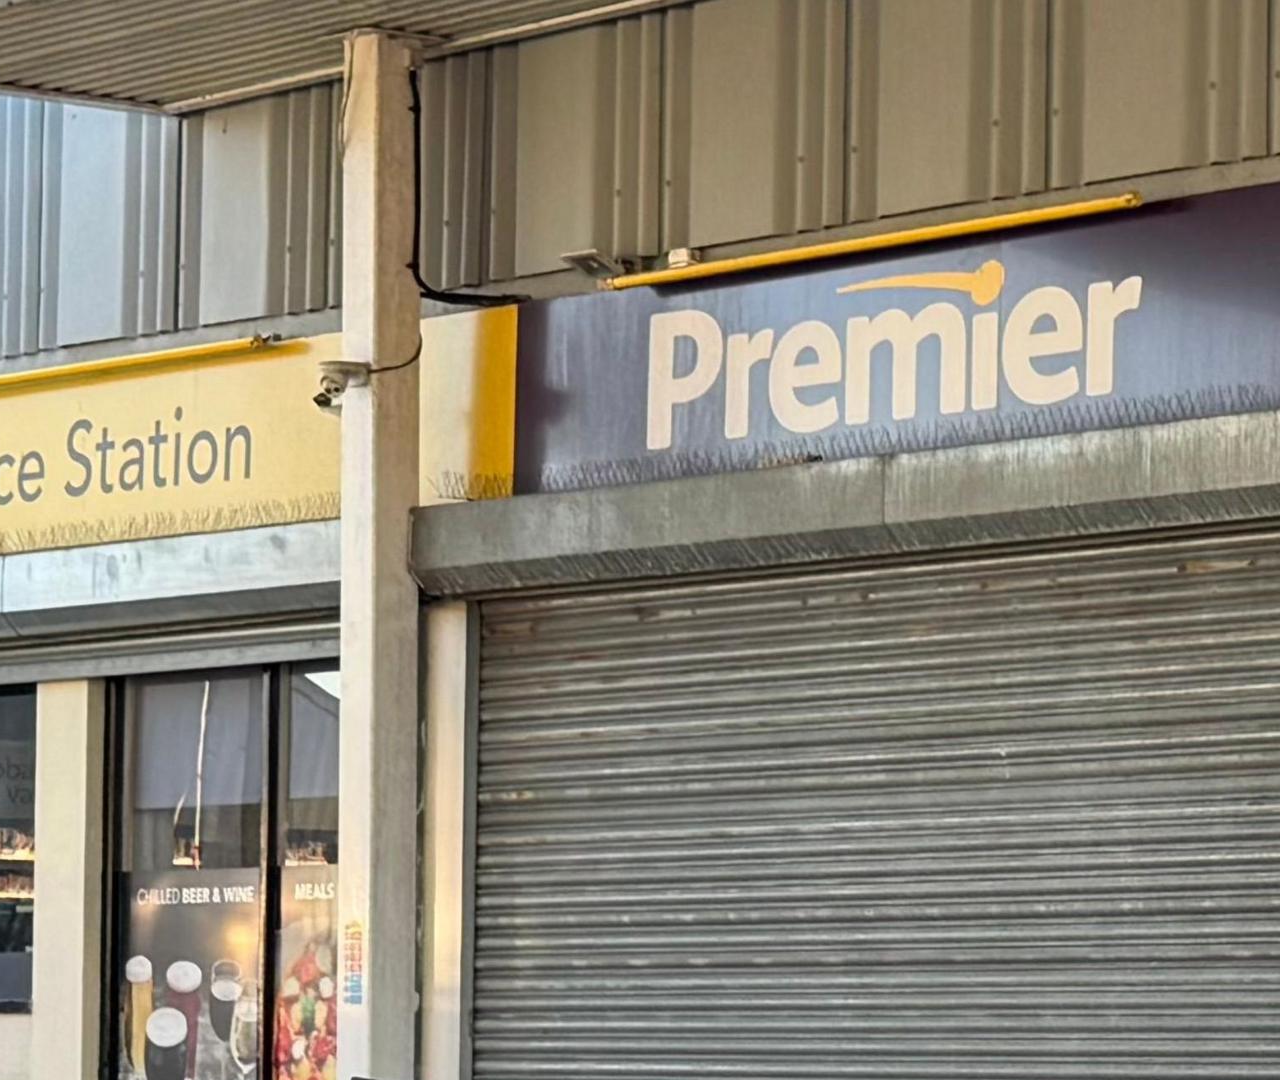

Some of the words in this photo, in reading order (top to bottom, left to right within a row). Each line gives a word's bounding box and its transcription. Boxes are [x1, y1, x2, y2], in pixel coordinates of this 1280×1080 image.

[646, 260, 1142, 450] Premier
[64, 406, 253, 498] Station
[136, 887, 180, 905] CHILLED
[181, 887, 211, 904] BEER
[212, 887, 221, 903] &
[223, 886, 255, 903] WINE
[294, 883, 335, 900] MEALS
